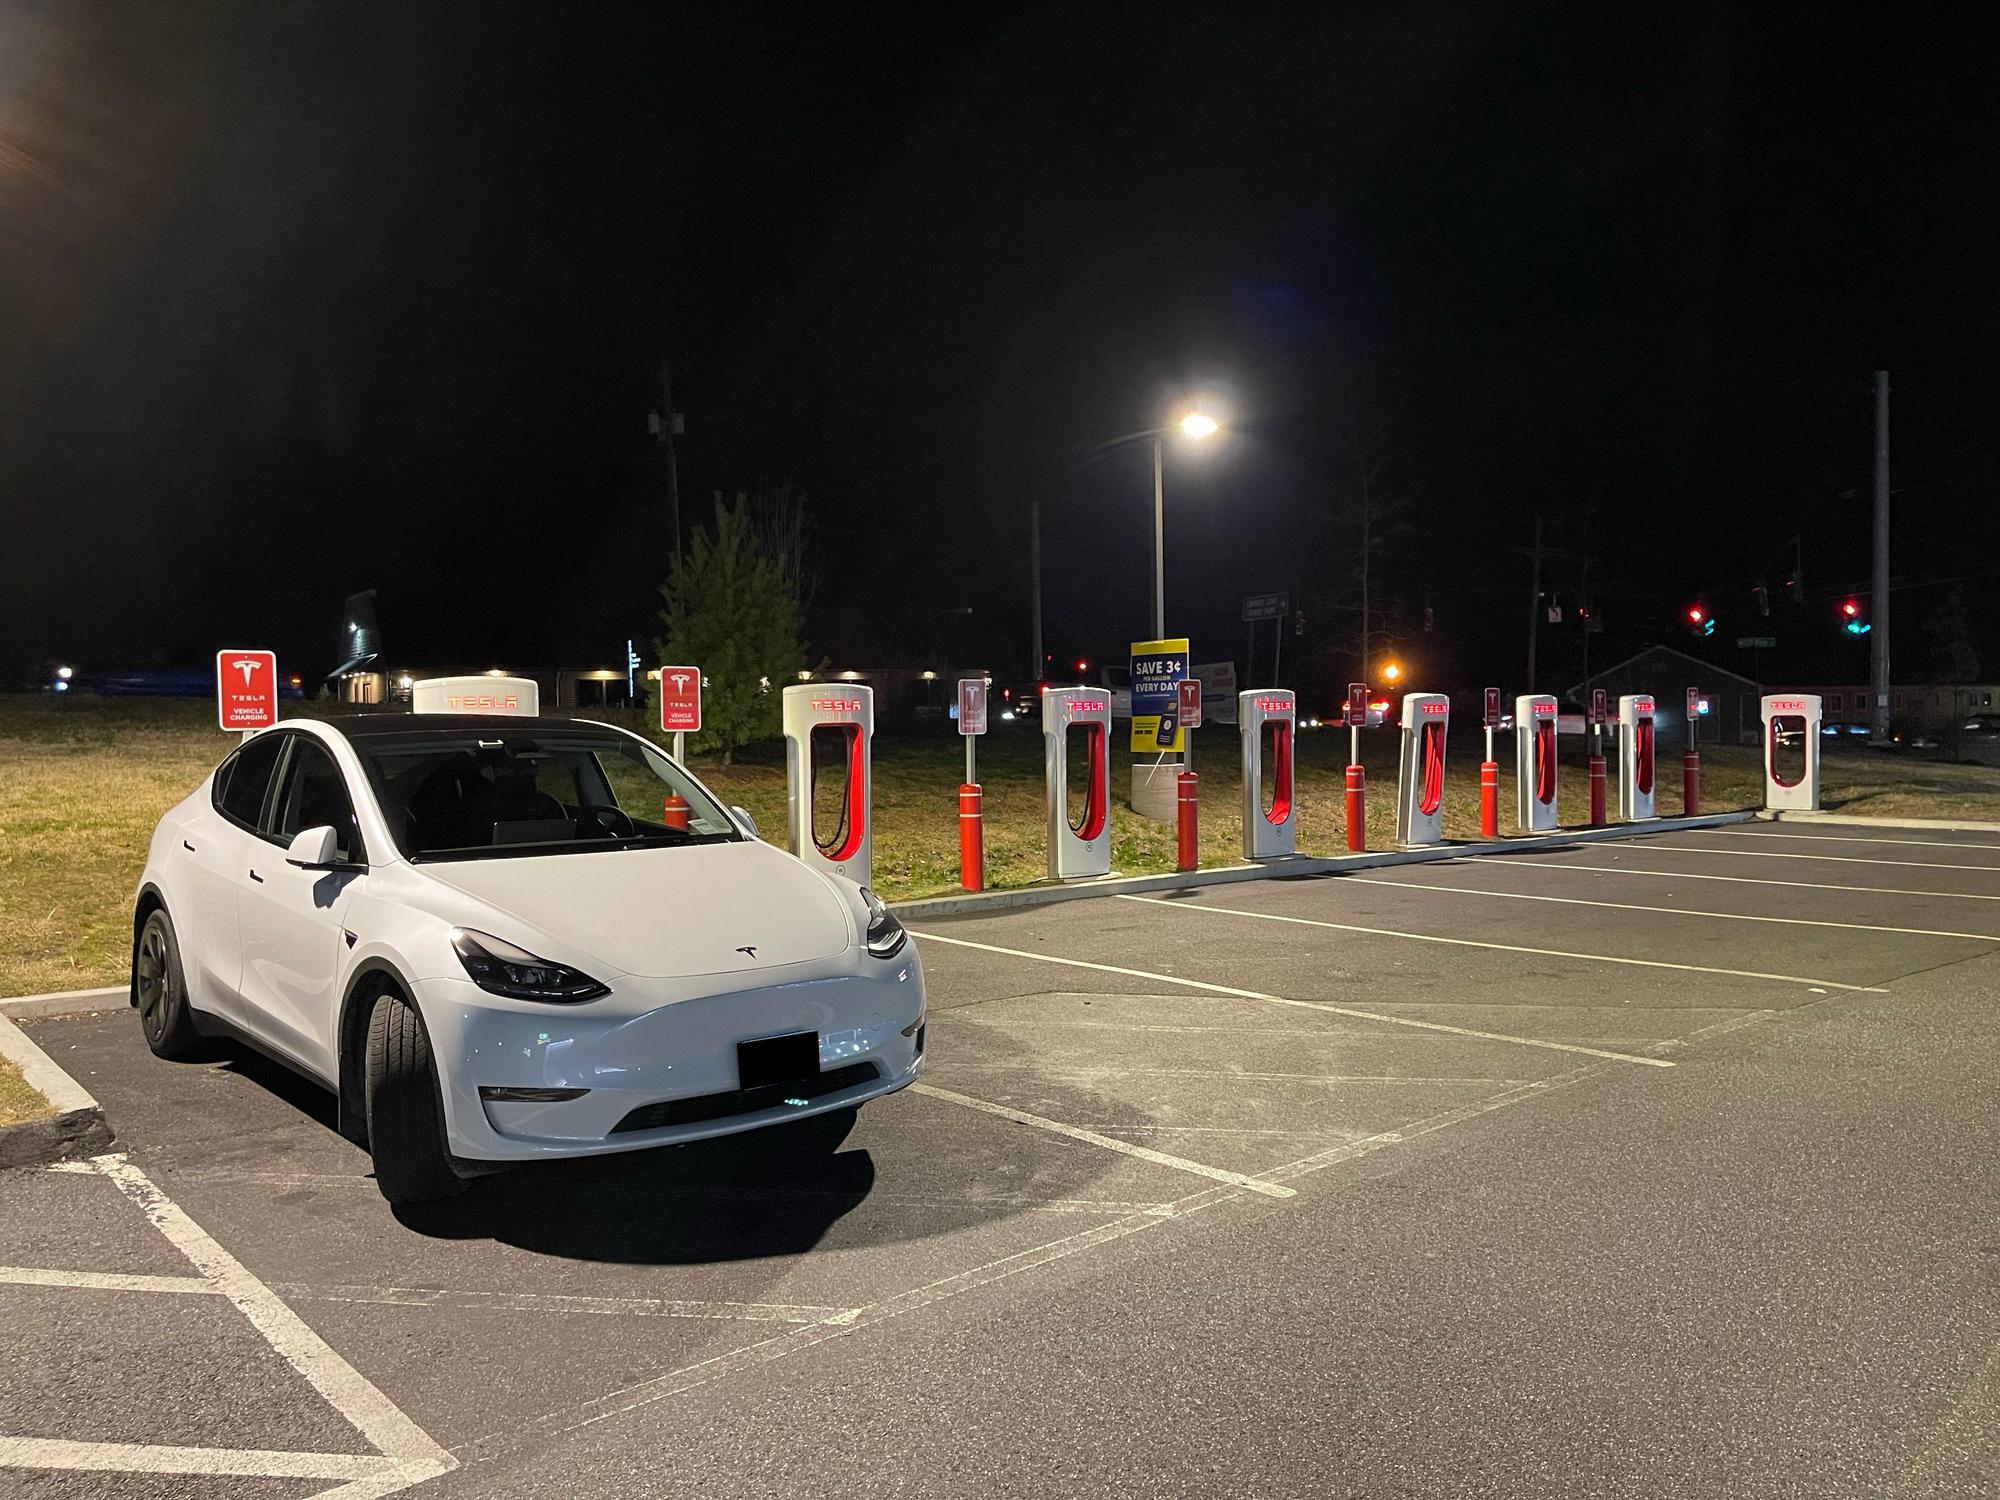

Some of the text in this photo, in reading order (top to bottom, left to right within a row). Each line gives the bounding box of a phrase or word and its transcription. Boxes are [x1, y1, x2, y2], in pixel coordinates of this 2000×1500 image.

[1136, 661, 1163, 675] SAVE
[1135, 681, 1179, 692] EVERY DAY
[447, 696, 518, 709] TESLA
[810, 700, 861, 711] TESLA
[1066, 702, 1104, 711] TESLA
[1261, 702, 1291, 710] TESLA
[1770, 702, 1805, 710] TESLA
